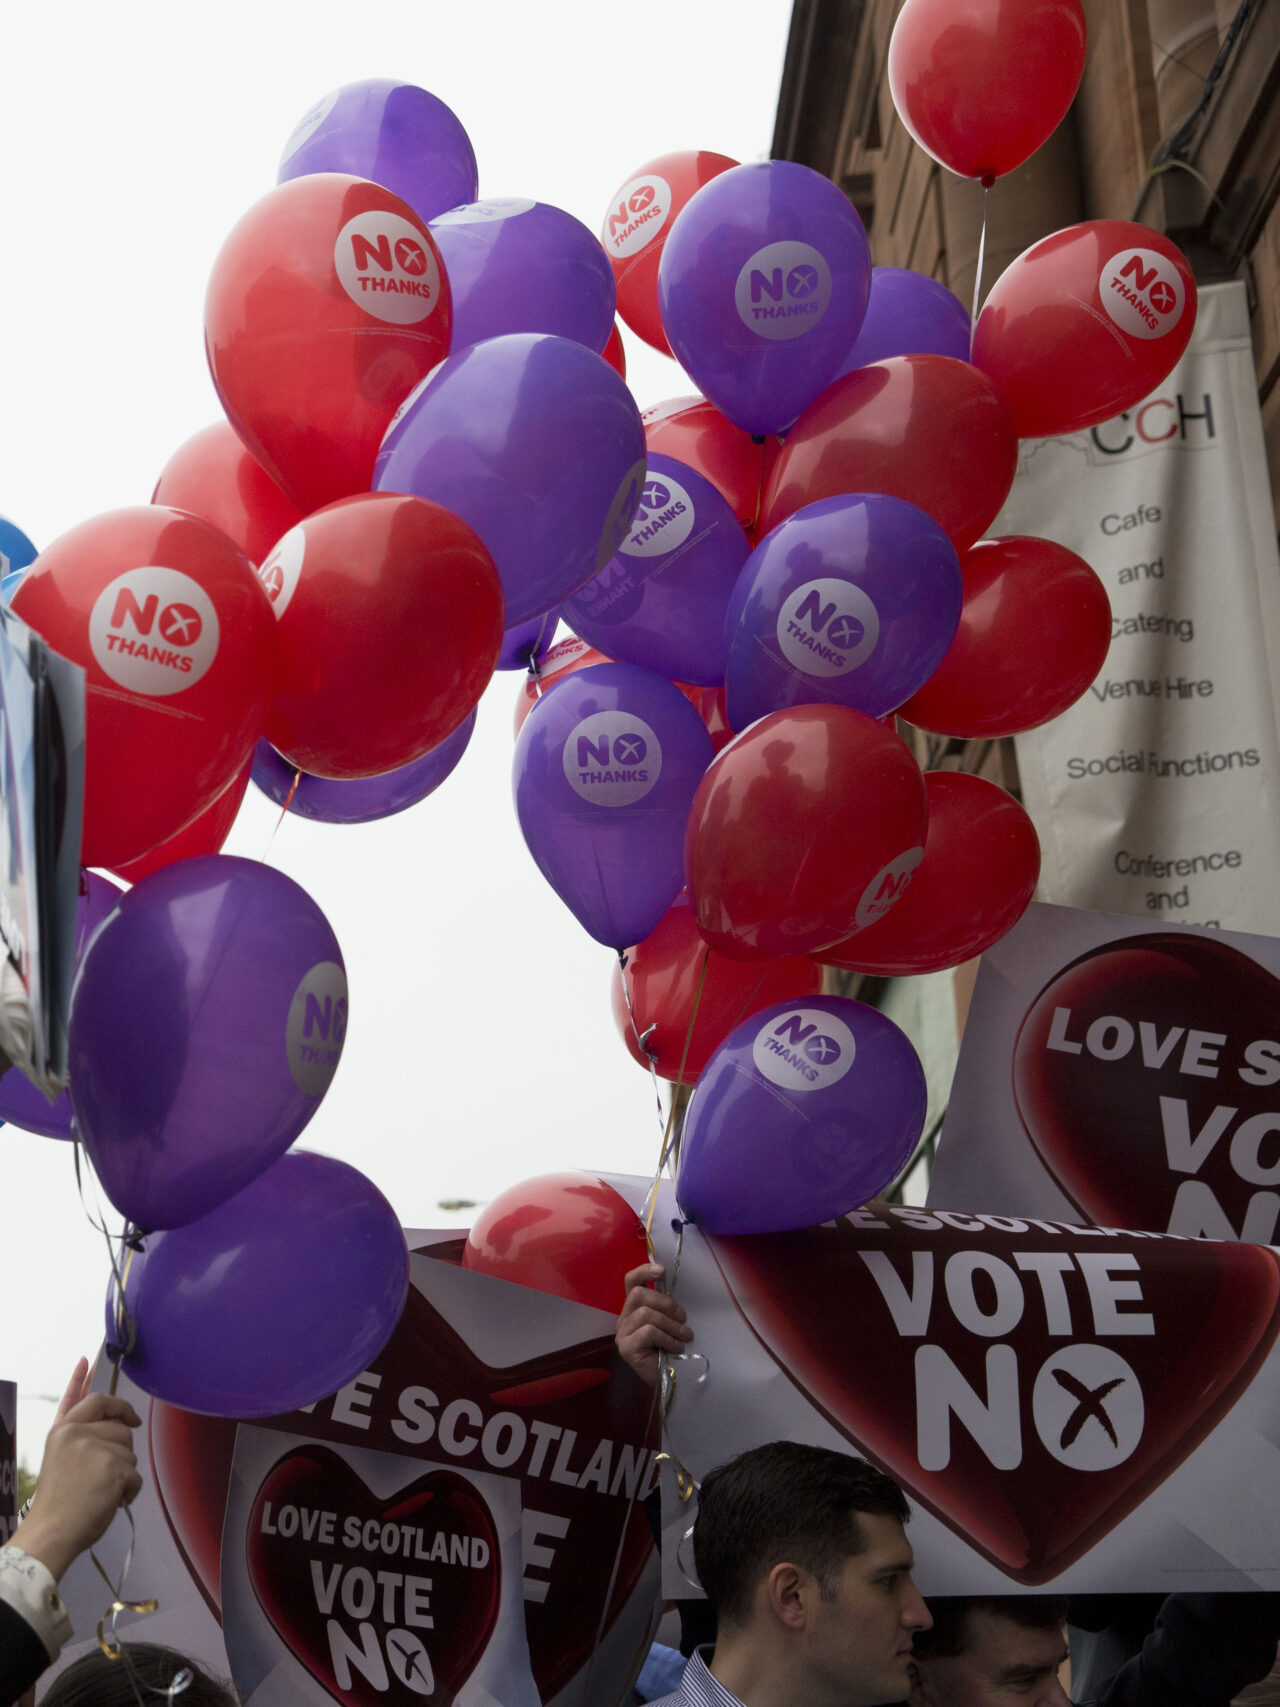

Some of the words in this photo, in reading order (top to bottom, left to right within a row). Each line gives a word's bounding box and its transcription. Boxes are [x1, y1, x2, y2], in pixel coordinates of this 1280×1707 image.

[609, 185, 655, 237] NO
[614, 205, 661, 247] THANKS
[351, 234, 427, 276] NO
[357, 277, 430, 299] THANKS
[750, 264, 819, 303] NO
[1110, 277, 1159, 330] THANKS
[1120, 255, 1177, 314] NO
[752, 301, 819, 320] THANKS
[630, 501, 687, 546] THANKS
[1100, 504, 1162, 536] Cafe
[1118, 556, 1164, 585] and
[110, 587, 202, 647] NO
[795, 590, 864, 649] NO
[106, 634, 193, 673] THANKS
[787, 620, 846, 667] THANKS
[1165, 677, 1214, 699] Hire
[577, 733, 648, 767] NO
[1067, 751, 1145, 779] Social
[1148, 748, 1260, 777] Functions
[579, 770, 648, 784] THANKS
[1114, 850, 1242, 878] Conference
[1146, 884, 1189, 910] and
[764, 1037, 819, 1081] THANKS
[774, 1015, 841, 1065] NO
[1046, 1007, 1227, 1079] LOVE
[858, 1251, 1155, 1336] VOTE
[914, 1344, 1145, 1472] NO
[391, 1386, 662, 1501] SCOTLAND
[261, 1501, 337, 1545] LOVE
[342, 1515, 490, 1569] SCOTLAND
[310, 1559, 434, 1629] VOTE
[327, 1618, 435, 1696] NO
